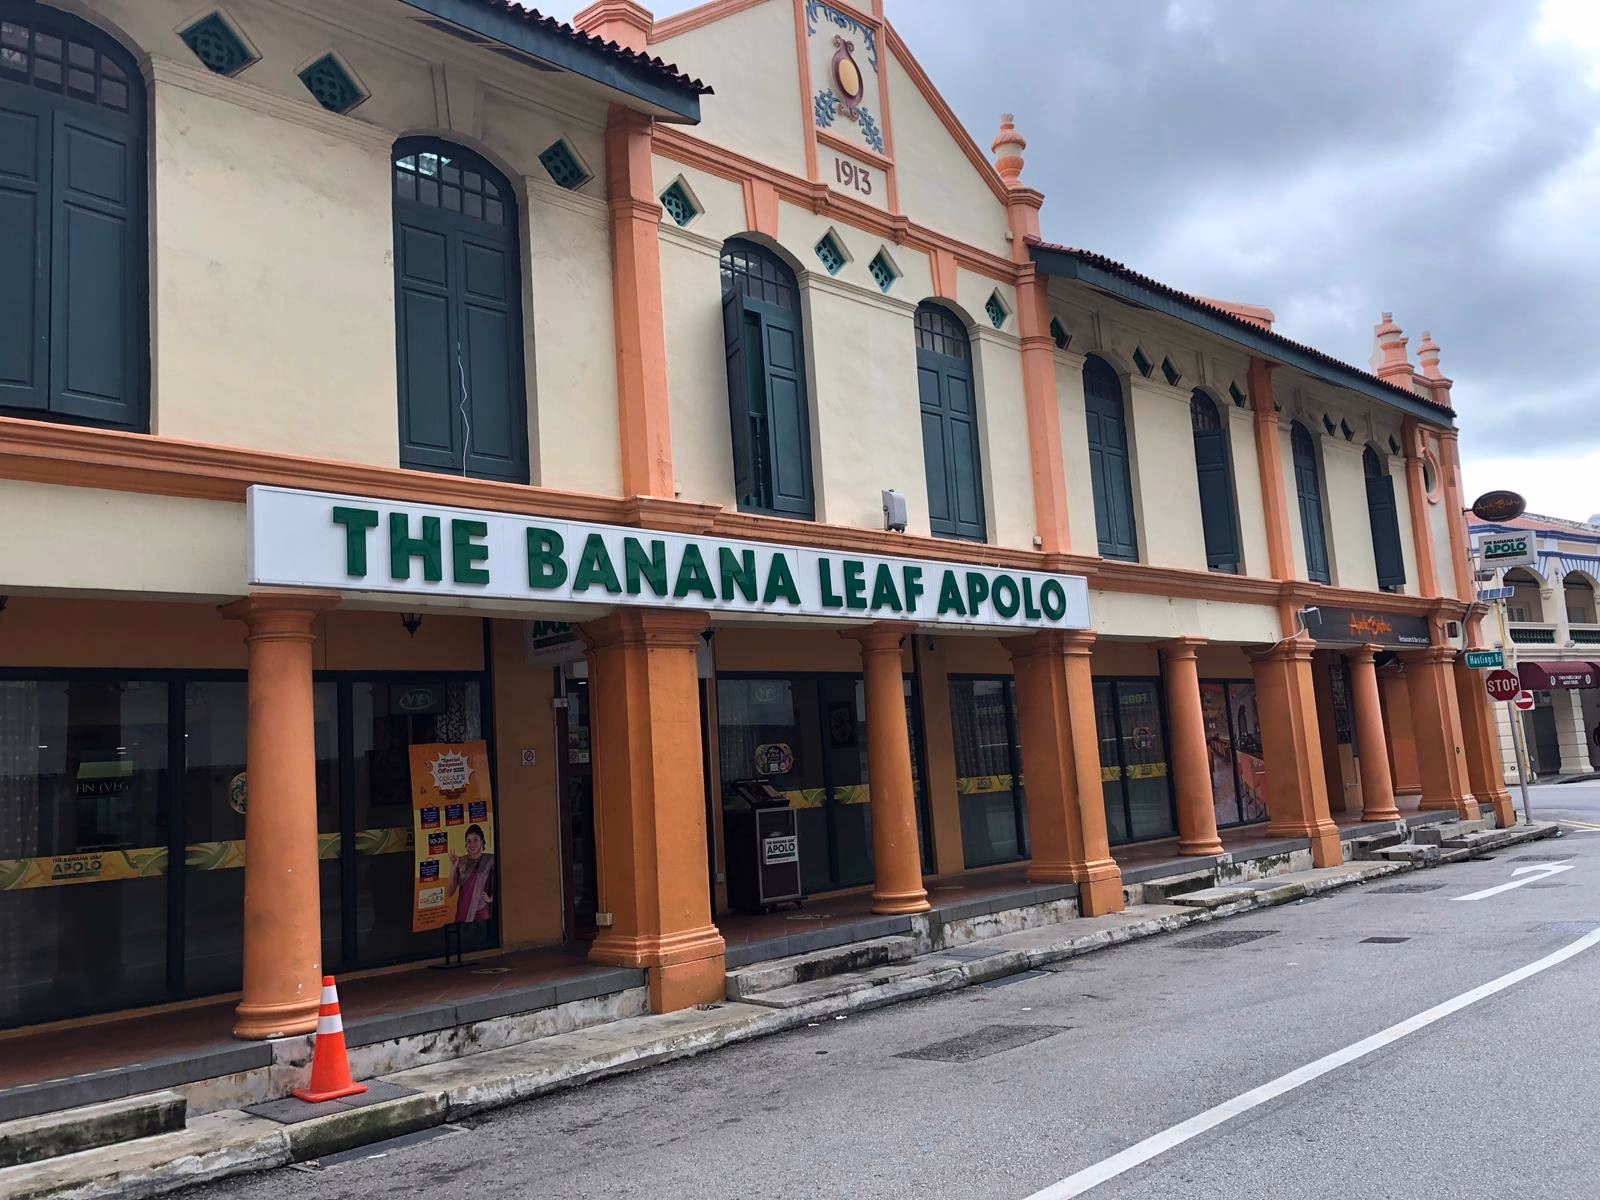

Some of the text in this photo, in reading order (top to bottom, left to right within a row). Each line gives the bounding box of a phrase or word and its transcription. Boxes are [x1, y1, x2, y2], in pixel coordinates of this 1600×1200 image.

[834, 157, 872, 196] 1913
[1485, 541, 1527, 555] APOLO
[332, 506, 1067, 621] THE BANANA LEAF APOLO
[1469, 653, 1503, 666] Hastings Rd
[1487, 678, 1518, 693] STOP
[767, 843, 795, 854] APOLO
[53, 860, 102, 874] APOLO
